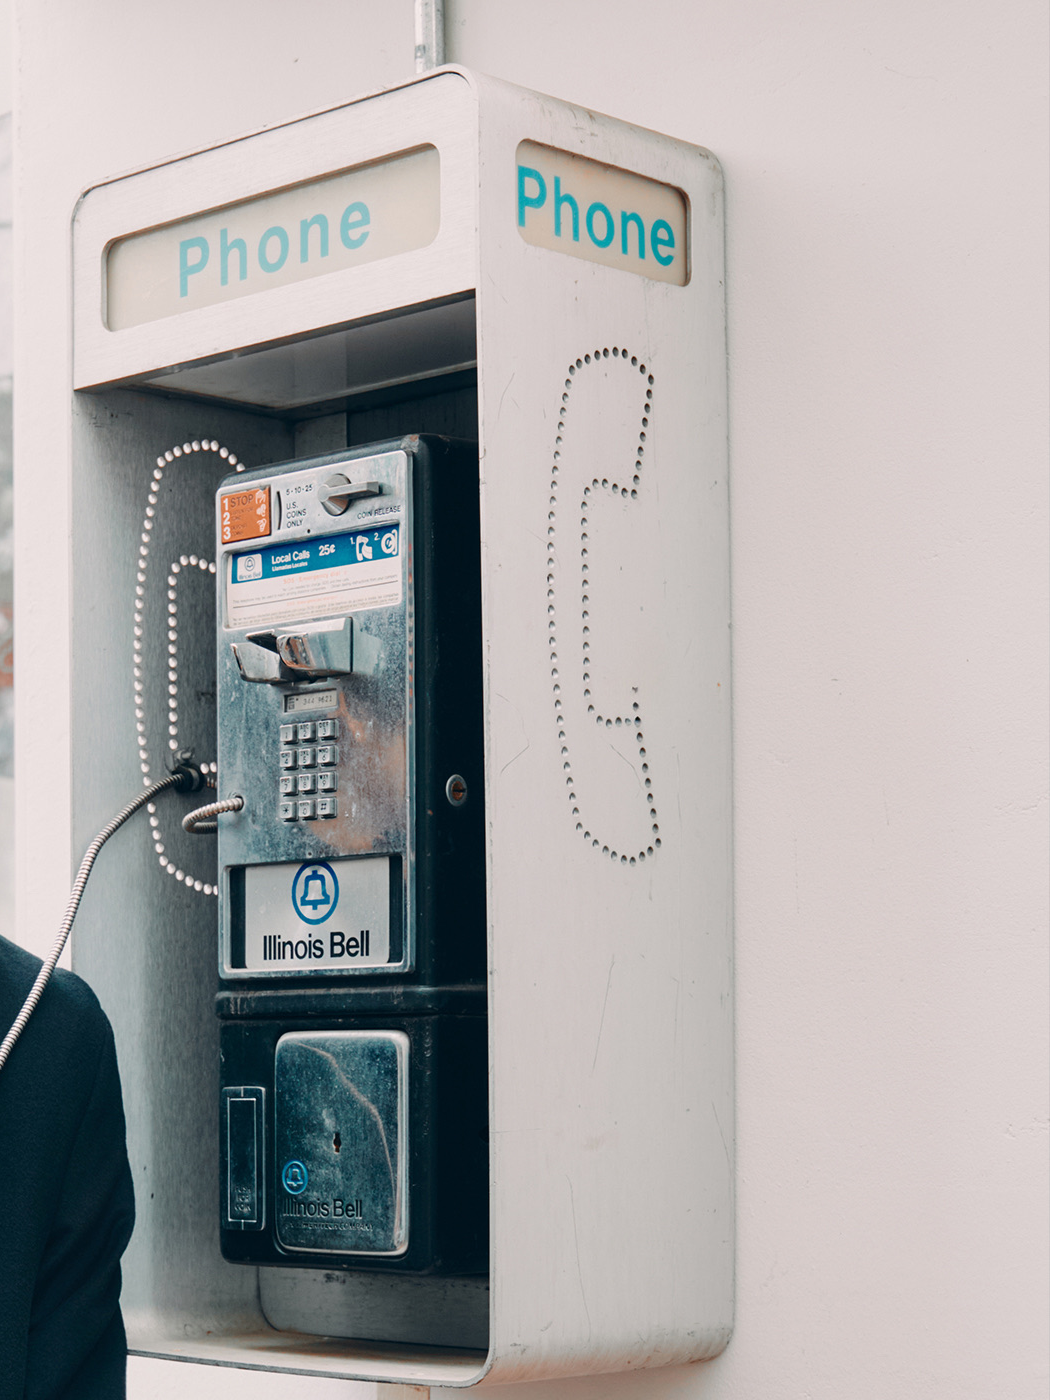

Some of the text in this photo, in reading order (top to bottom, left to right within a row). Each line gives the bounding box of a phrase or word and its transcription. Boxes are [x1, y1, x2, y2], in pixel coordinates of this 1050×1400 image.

[517, 165, 676, 267] Phone
[178, 200, 372, 298] Phone
[223, 494, 254, 511] 1 STOP
[286, 502, 299, 510] U.S.
[223, 512, 230, 526] 2
[286, 508, 308, 520] COINS
[357, 504, 401, 520] COIN RELEASE
[286, 520, 304, 529] ONLY
[223, 526, 231, 540] 3
[272, 544, 336, 565] Local Calls 25¢
[263, 930, 370, 961] Illinois Bell
[282, 1198, 362, 1220] Illinois Bell
